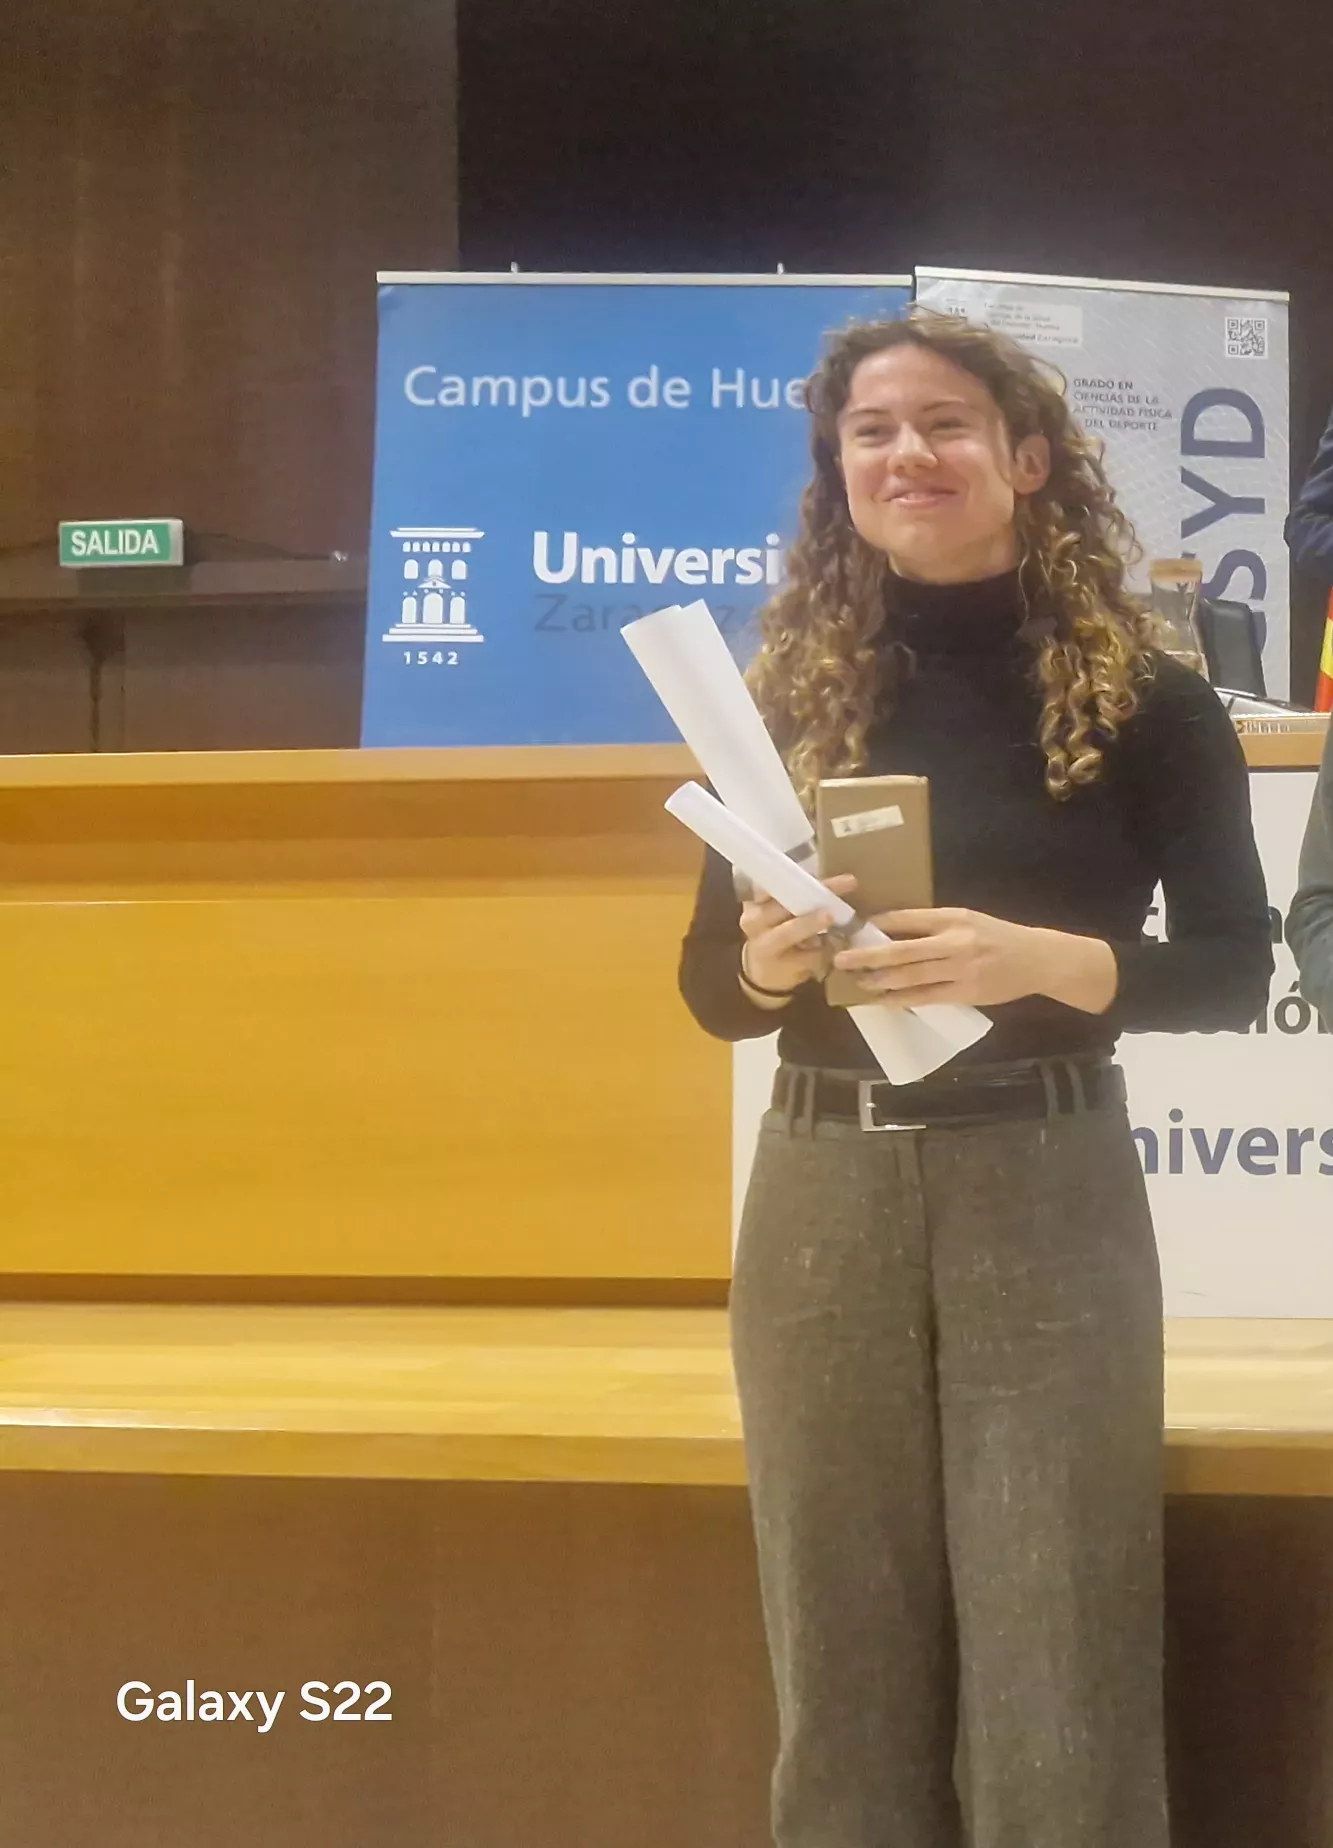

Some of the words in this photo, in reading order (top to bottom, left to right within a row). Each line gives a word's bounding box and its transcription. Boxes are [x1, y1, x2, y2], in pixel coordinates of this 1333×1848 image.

[404, 364, 611, 418] Campus
[628, 363, 692, 409] de
[712, 366, 809, 410] Hue
[1073, 378, 1115, 390] GRADO
[1118, 380, 1133, 390] EN
[71, 528, 160, 557] SALIDA
[533, 530, 782, 586] Universi
[403, 650, 459, 666] 1542
